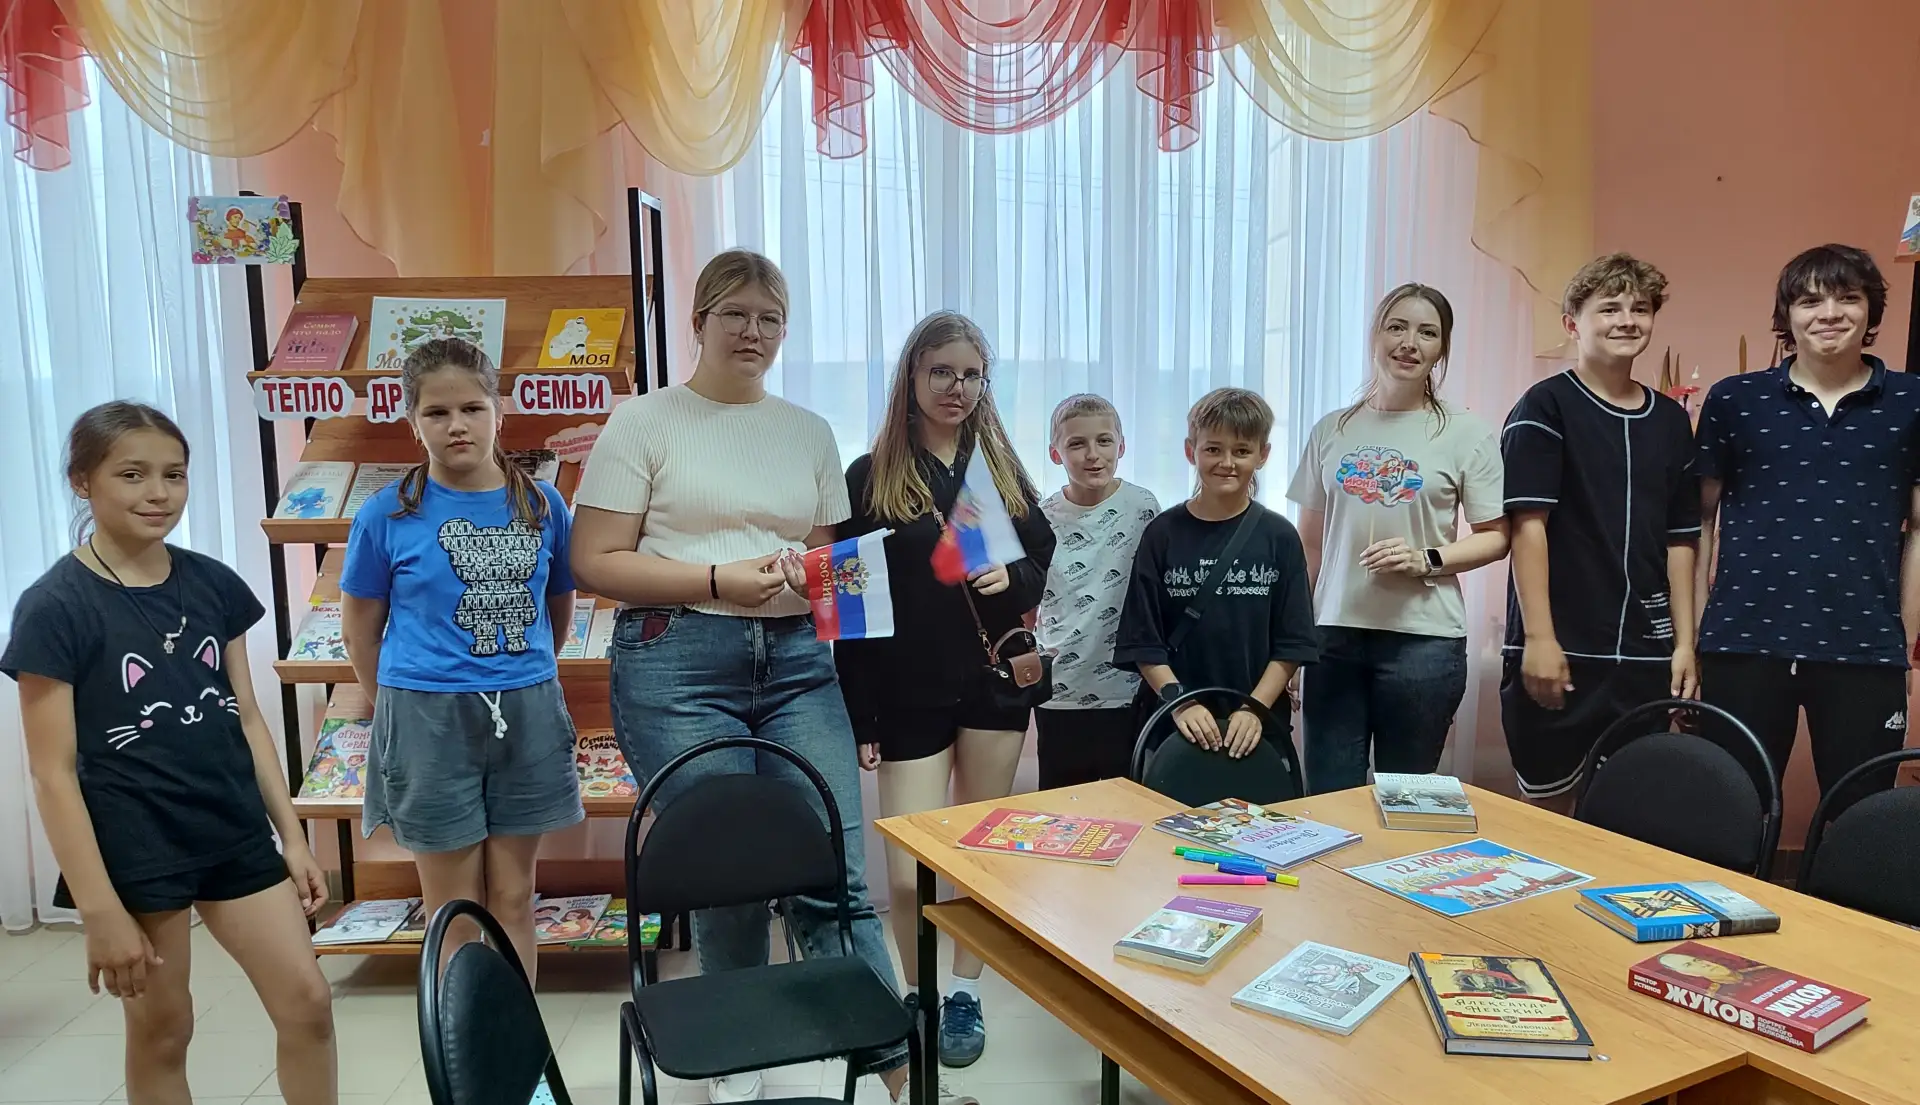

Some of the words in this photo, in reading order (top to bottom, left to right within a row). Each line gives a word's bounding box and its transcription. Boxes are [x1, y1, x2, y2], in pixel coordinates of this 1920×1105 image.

[375, 352, 403, 369] Мо
[262, 382, 344, 413] ТЕПЛО
[372, 383, 403, 419] ДР
[520, 379, 604, 410] СЕМЬИ
[1356, 460, 1370, 472] 12
[1344, 477, 1378, 489] ИЮНЯ
[1385, 863, 1419, 875] 12
[1633, 974, 1658, 987] ВИКТОР
[1633, 981, 1662, 995] УСТИНОВ
[1664, 982, 1756, 1030] ЖУКОВ
[1764, 983, 1832, 1018] ЖУКОВ
